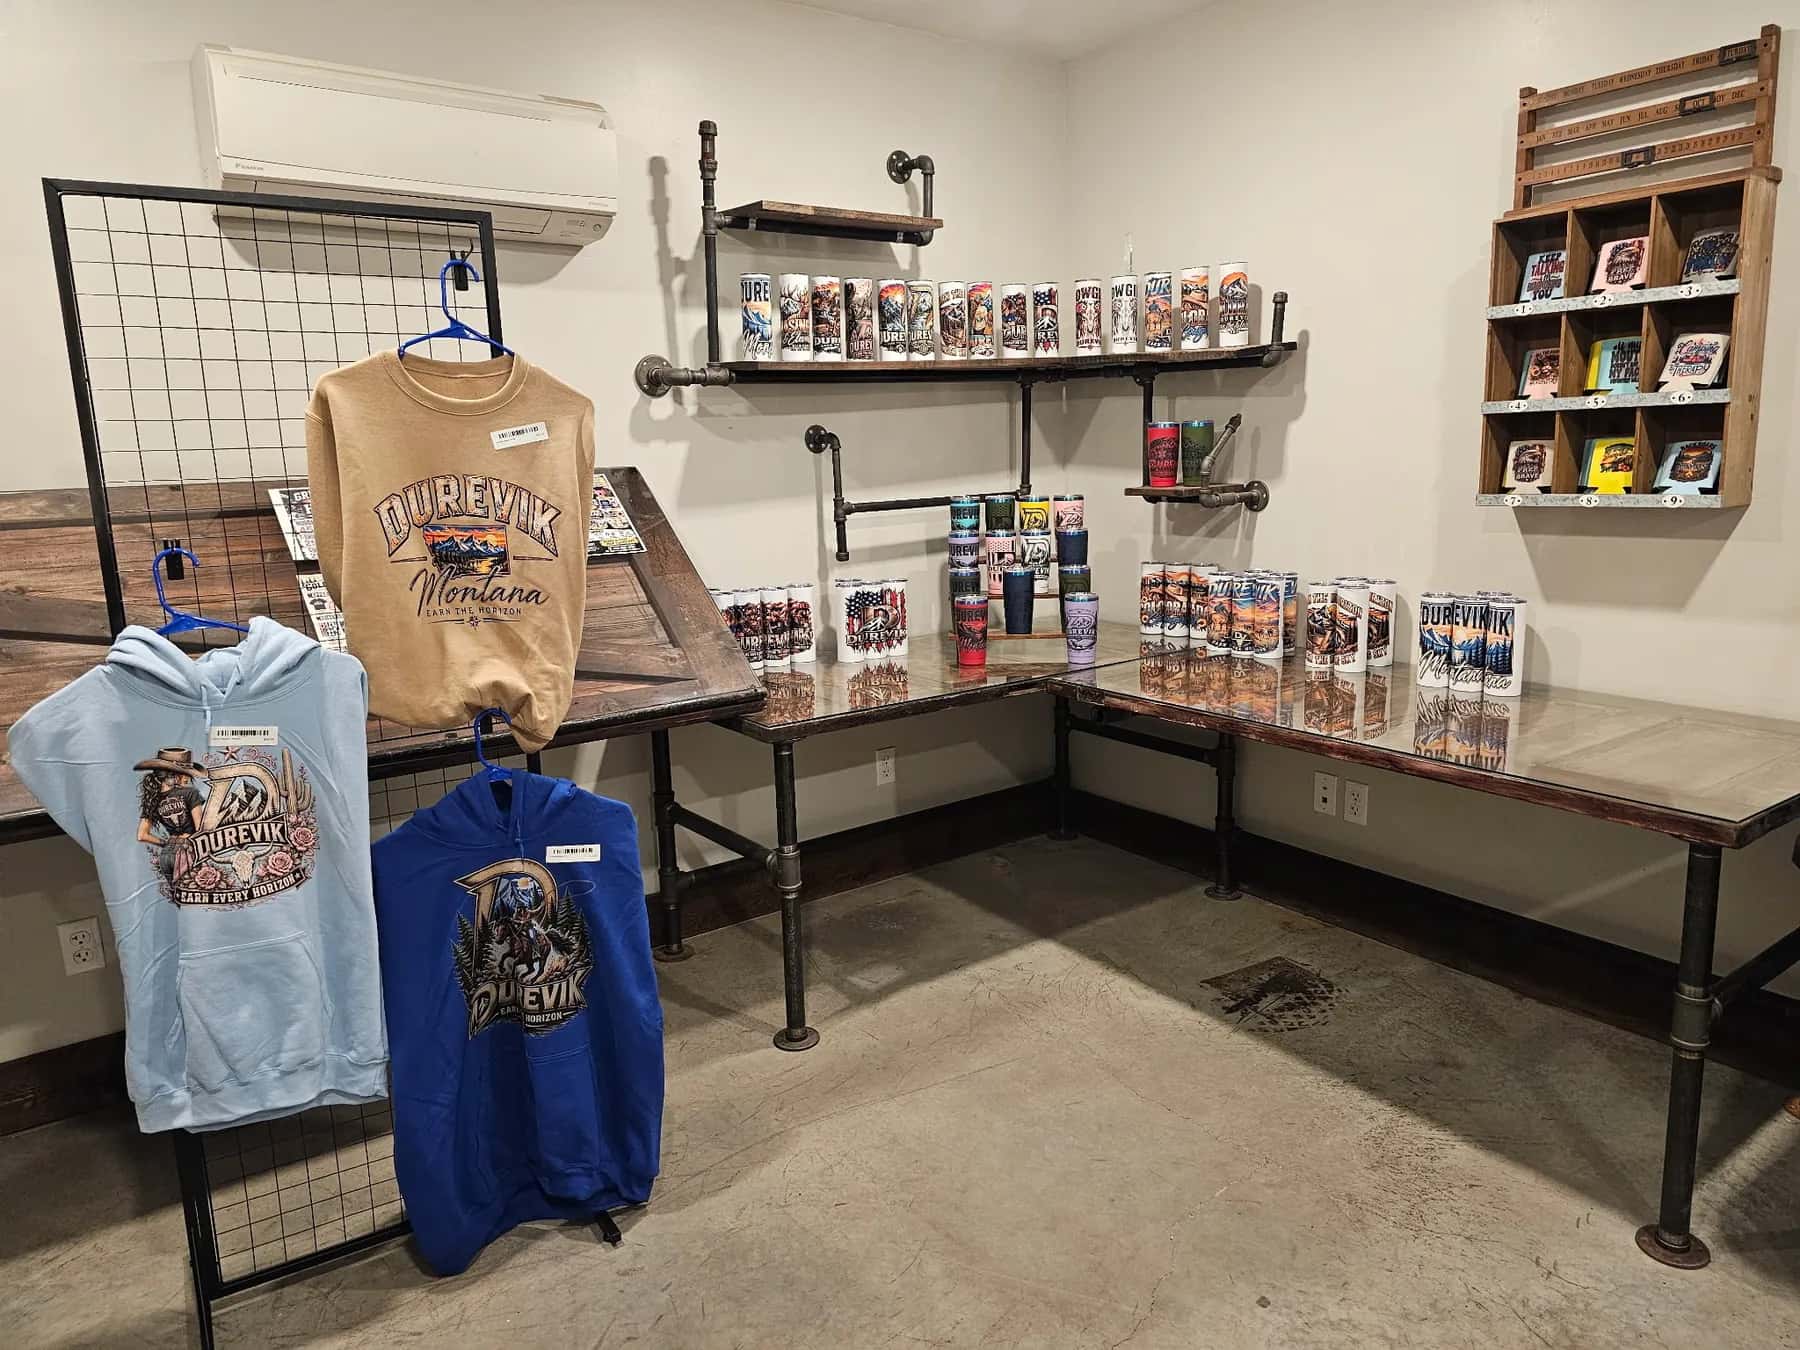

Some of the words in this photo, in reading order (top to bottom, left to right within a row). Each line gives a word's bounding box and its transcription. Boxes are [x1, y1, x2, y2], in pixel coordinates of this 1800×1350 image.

[1656, 61, 1685, 75] THURSDAY
[1538, 252, 1562, 264] KEEP
[1531, 260, 1565, 275] TALKING
[741, 281, 770, 302] URE
[1531, 288, 1553, 301] YOU
[1685, 286, 1693, 297] 3
[1599, 296, 1607, 305] 2
[1592, 397, 1600, 408] 5
[1678, 393, 1686, 402] 6
[1510, 496, 1516, 505] 7
[1586, 496, 1592, 505] 8
[1670, 495, 1678, 505] 9
[373, 473, 562, 558] DUREVIK
[409, 563, 551, 617] Montana
[426, 608, 451, 617] EARN
[455, 607, 474, 616] THE
[479, 606, 522, 616] HORIZON
[846, 628, 907, 646] DUREVIK
[193, 821, 286, 861] DUREVIK
[180, 891, 209, 903] EARN
[212, 889, 249, 904] EVERY
[253, 873, 296, 898] HORIZON
[468, 963, 593, 1041] DUEVIK
[525, 1011, 563, 1024] HORIZON
